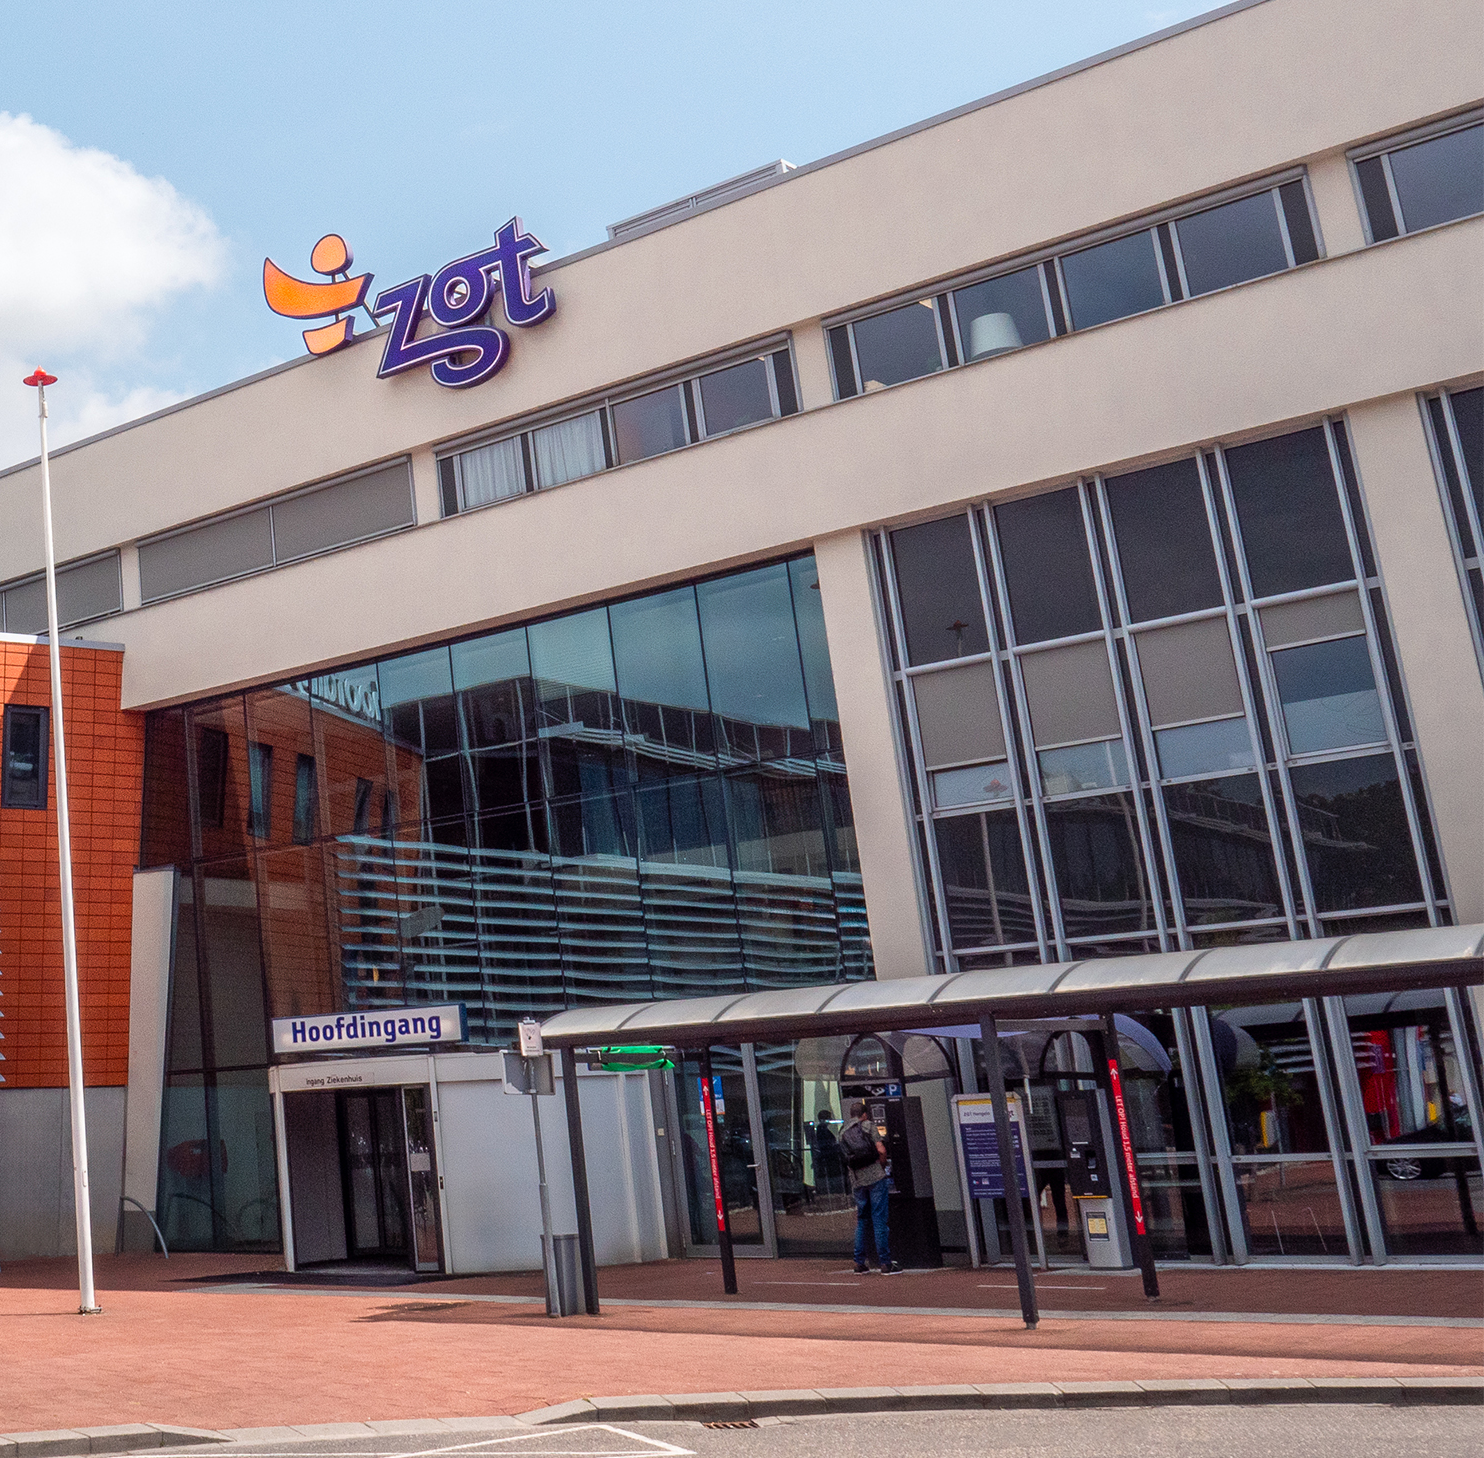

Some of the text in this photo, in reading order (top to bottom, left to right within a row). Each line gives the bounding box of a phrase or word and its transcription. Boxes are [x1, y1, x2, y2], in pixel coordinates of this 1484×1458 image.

[372, 216, 556, 389] zgt
[291, 1015, 442, 1043] Hoofdingang
[306, 1074, 363, 1087] Ingang Ziekenhuis
[1115, 1095, 1124, 1107] LET
[1120, 1121, 1129, 1139] Houd
[1122, 1141, 1131, 1152] 1,5
[1125, 1153, 1133, 1172] meter
[1128, 1174, 1139, 1198] afstand
